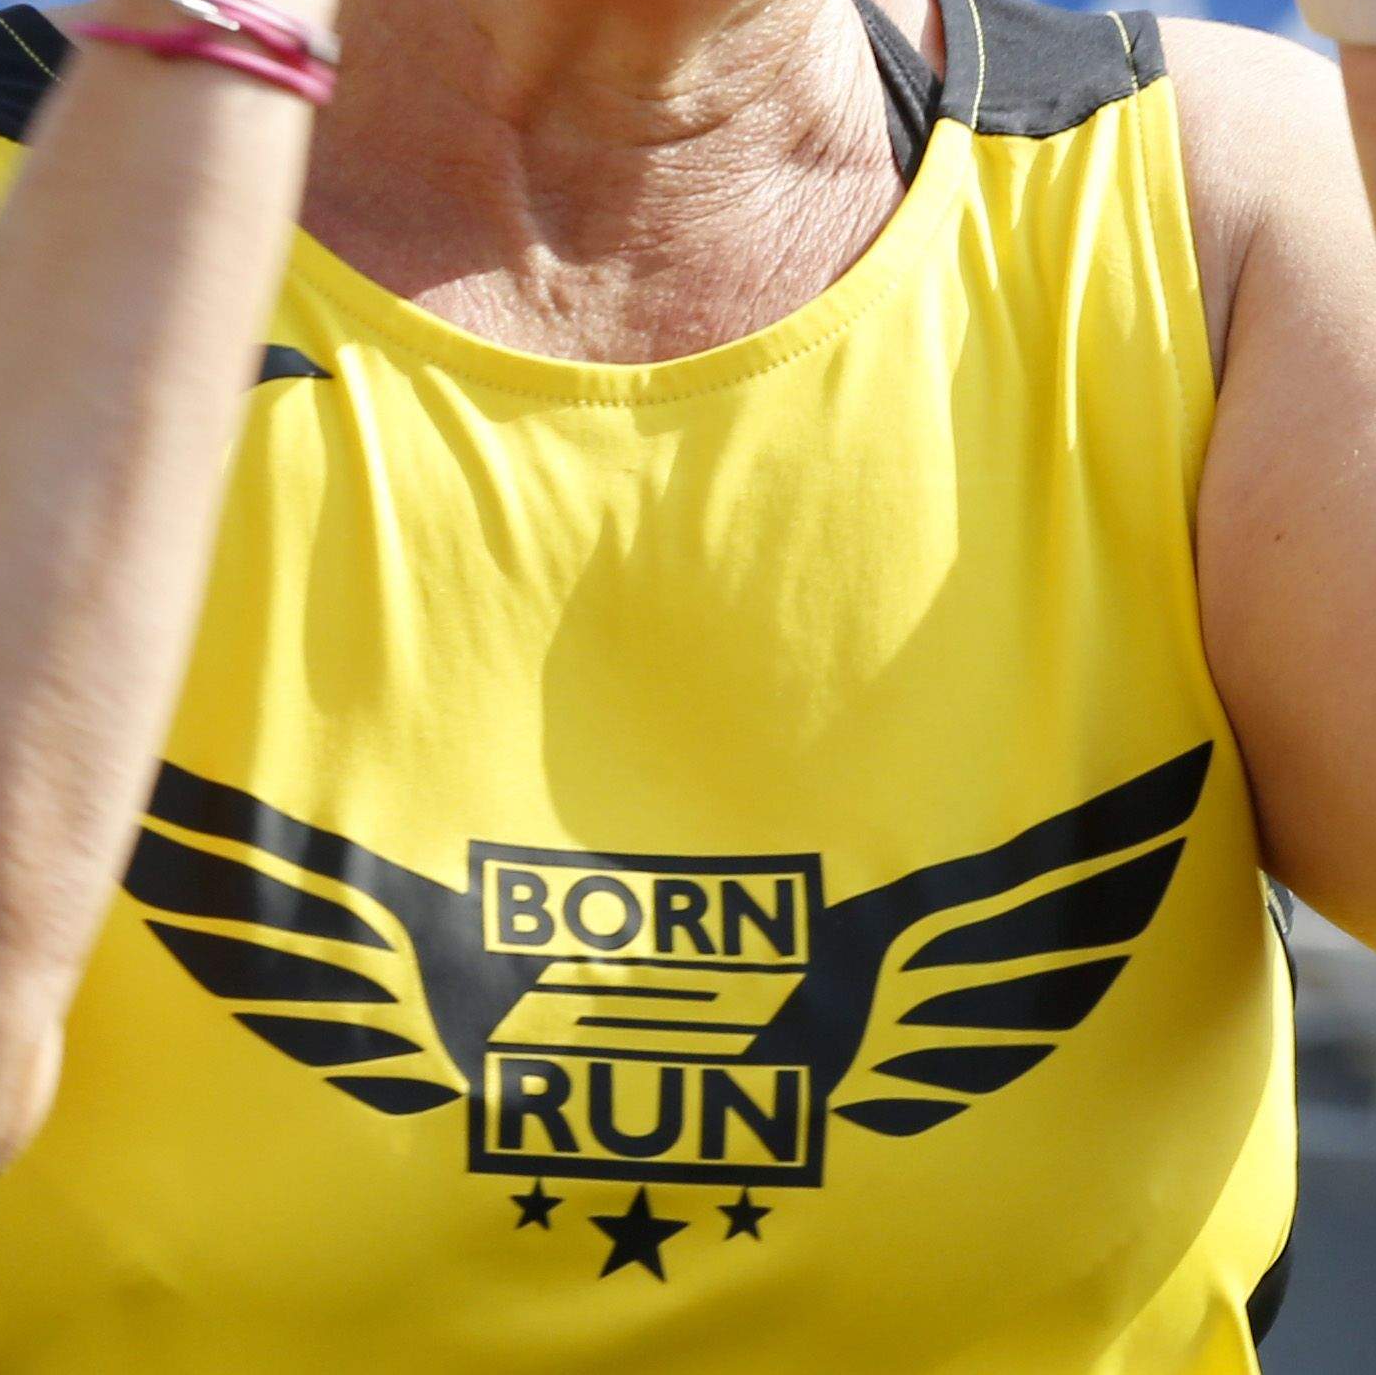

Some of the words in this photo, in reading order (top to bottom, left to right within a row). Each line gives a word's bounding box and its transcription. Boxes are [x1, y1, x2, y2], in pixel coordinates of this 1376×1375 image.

[496, 867, 795, 957] BORN
[486, 961, 807, 1056] 2
[496, 1057, 801, 1162] RUN
